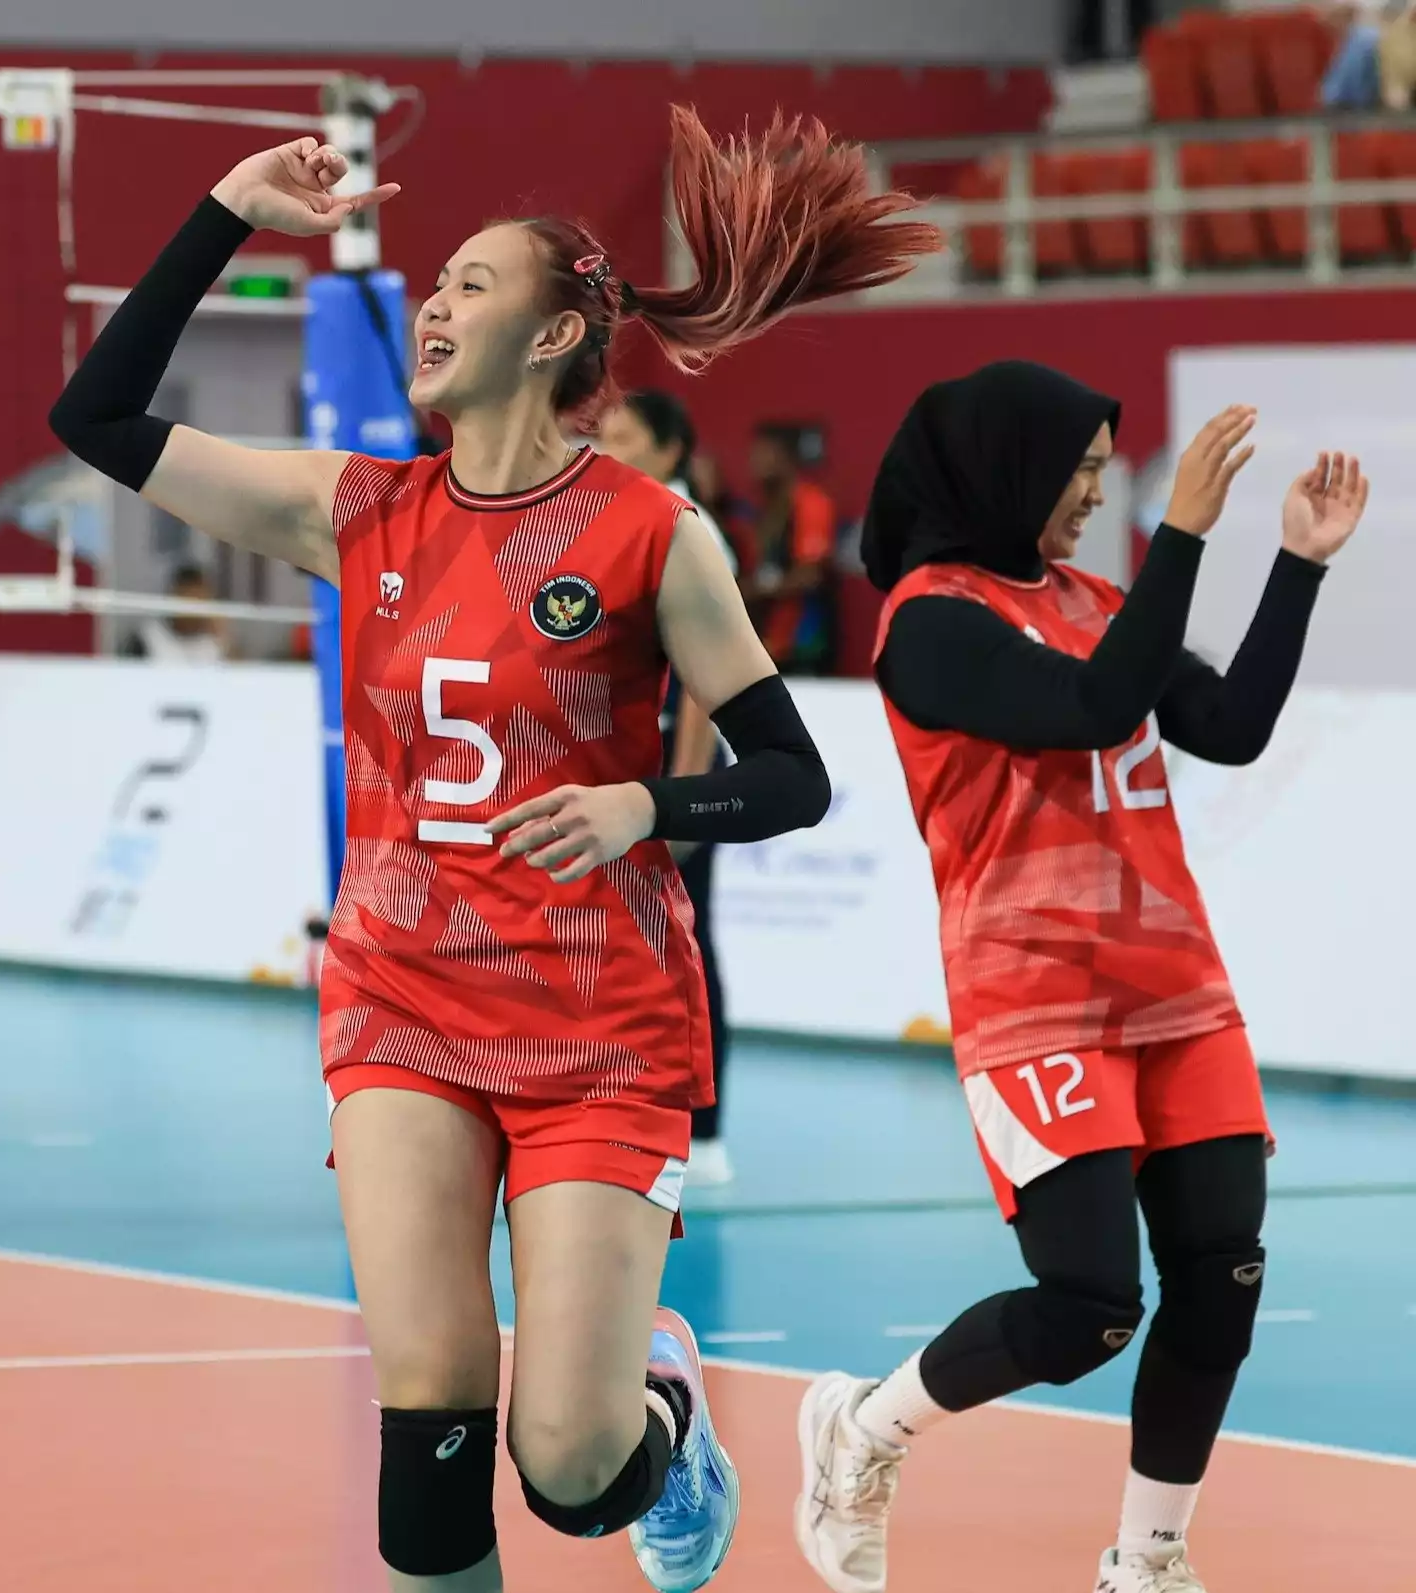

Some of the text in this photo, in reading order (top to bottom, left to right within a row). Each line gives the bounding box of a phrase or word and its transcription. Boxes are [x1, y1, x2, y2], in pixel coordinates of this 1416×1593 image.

[539, 575, 597, 597] TIM INDONESIA
[421, 656, 503, 806] 5
[1092, 708, 1167, 814] 12
[1016, 1051, 1096, 1126] 12
